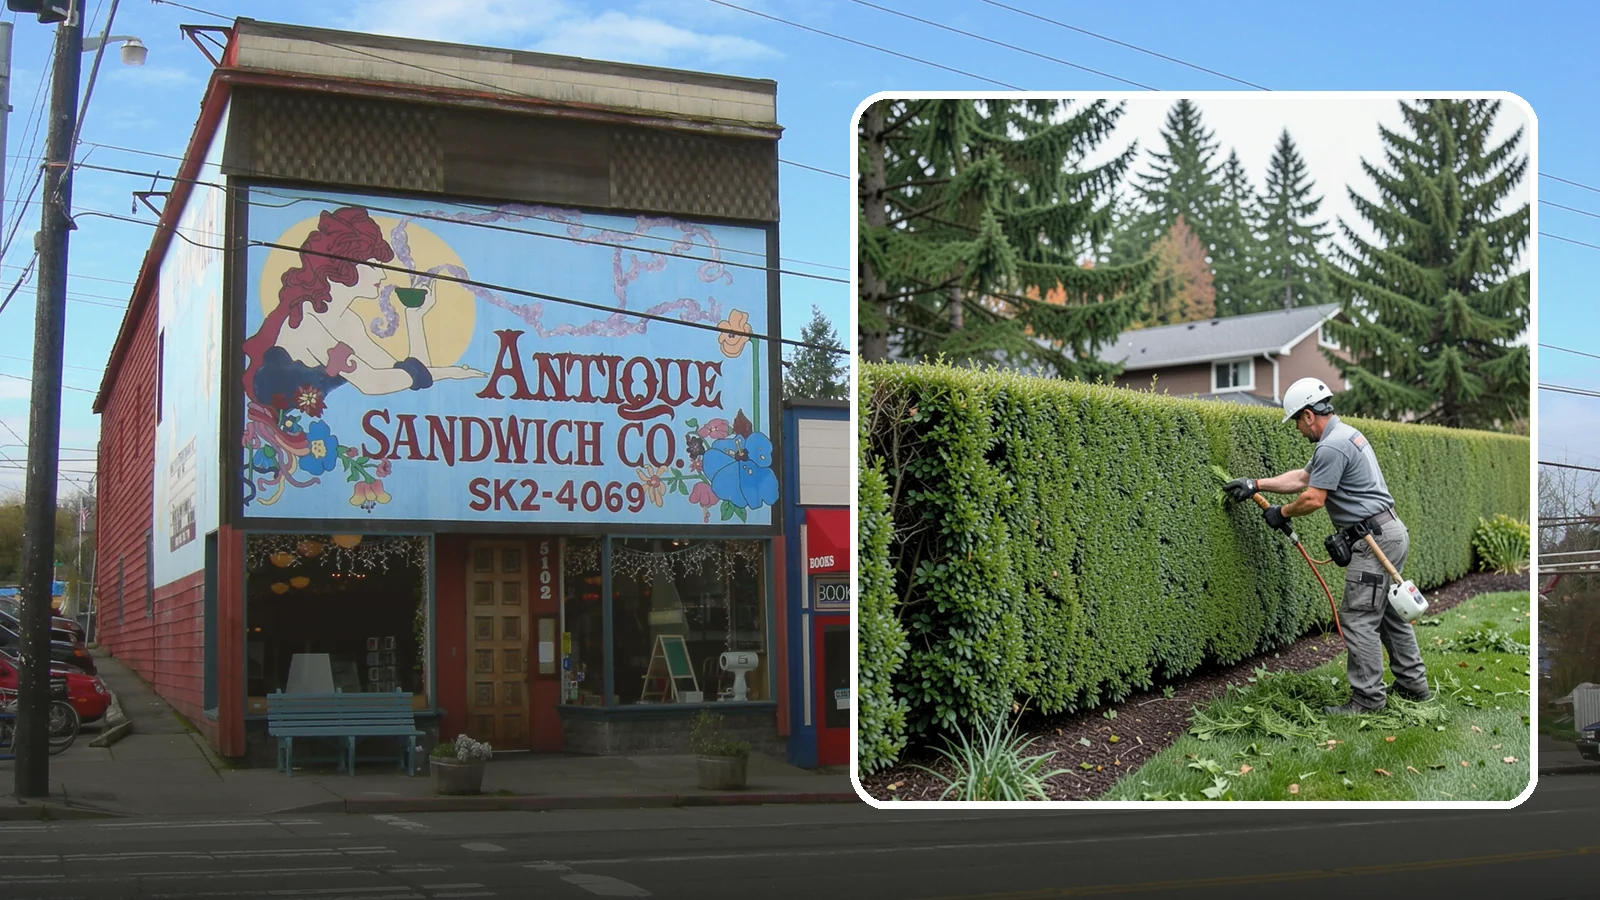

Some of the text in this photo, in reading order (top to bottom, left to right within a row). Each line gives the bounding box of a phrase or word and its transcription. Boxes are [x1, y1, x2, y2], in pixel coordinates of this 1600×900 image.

[361, 409, 685, 468] SANDWICH CO.
[468, 477, 646, 513] SK2-4069
[539, 541, 551, 600] 5102
[809, 555, 835, 568] BOOKS
